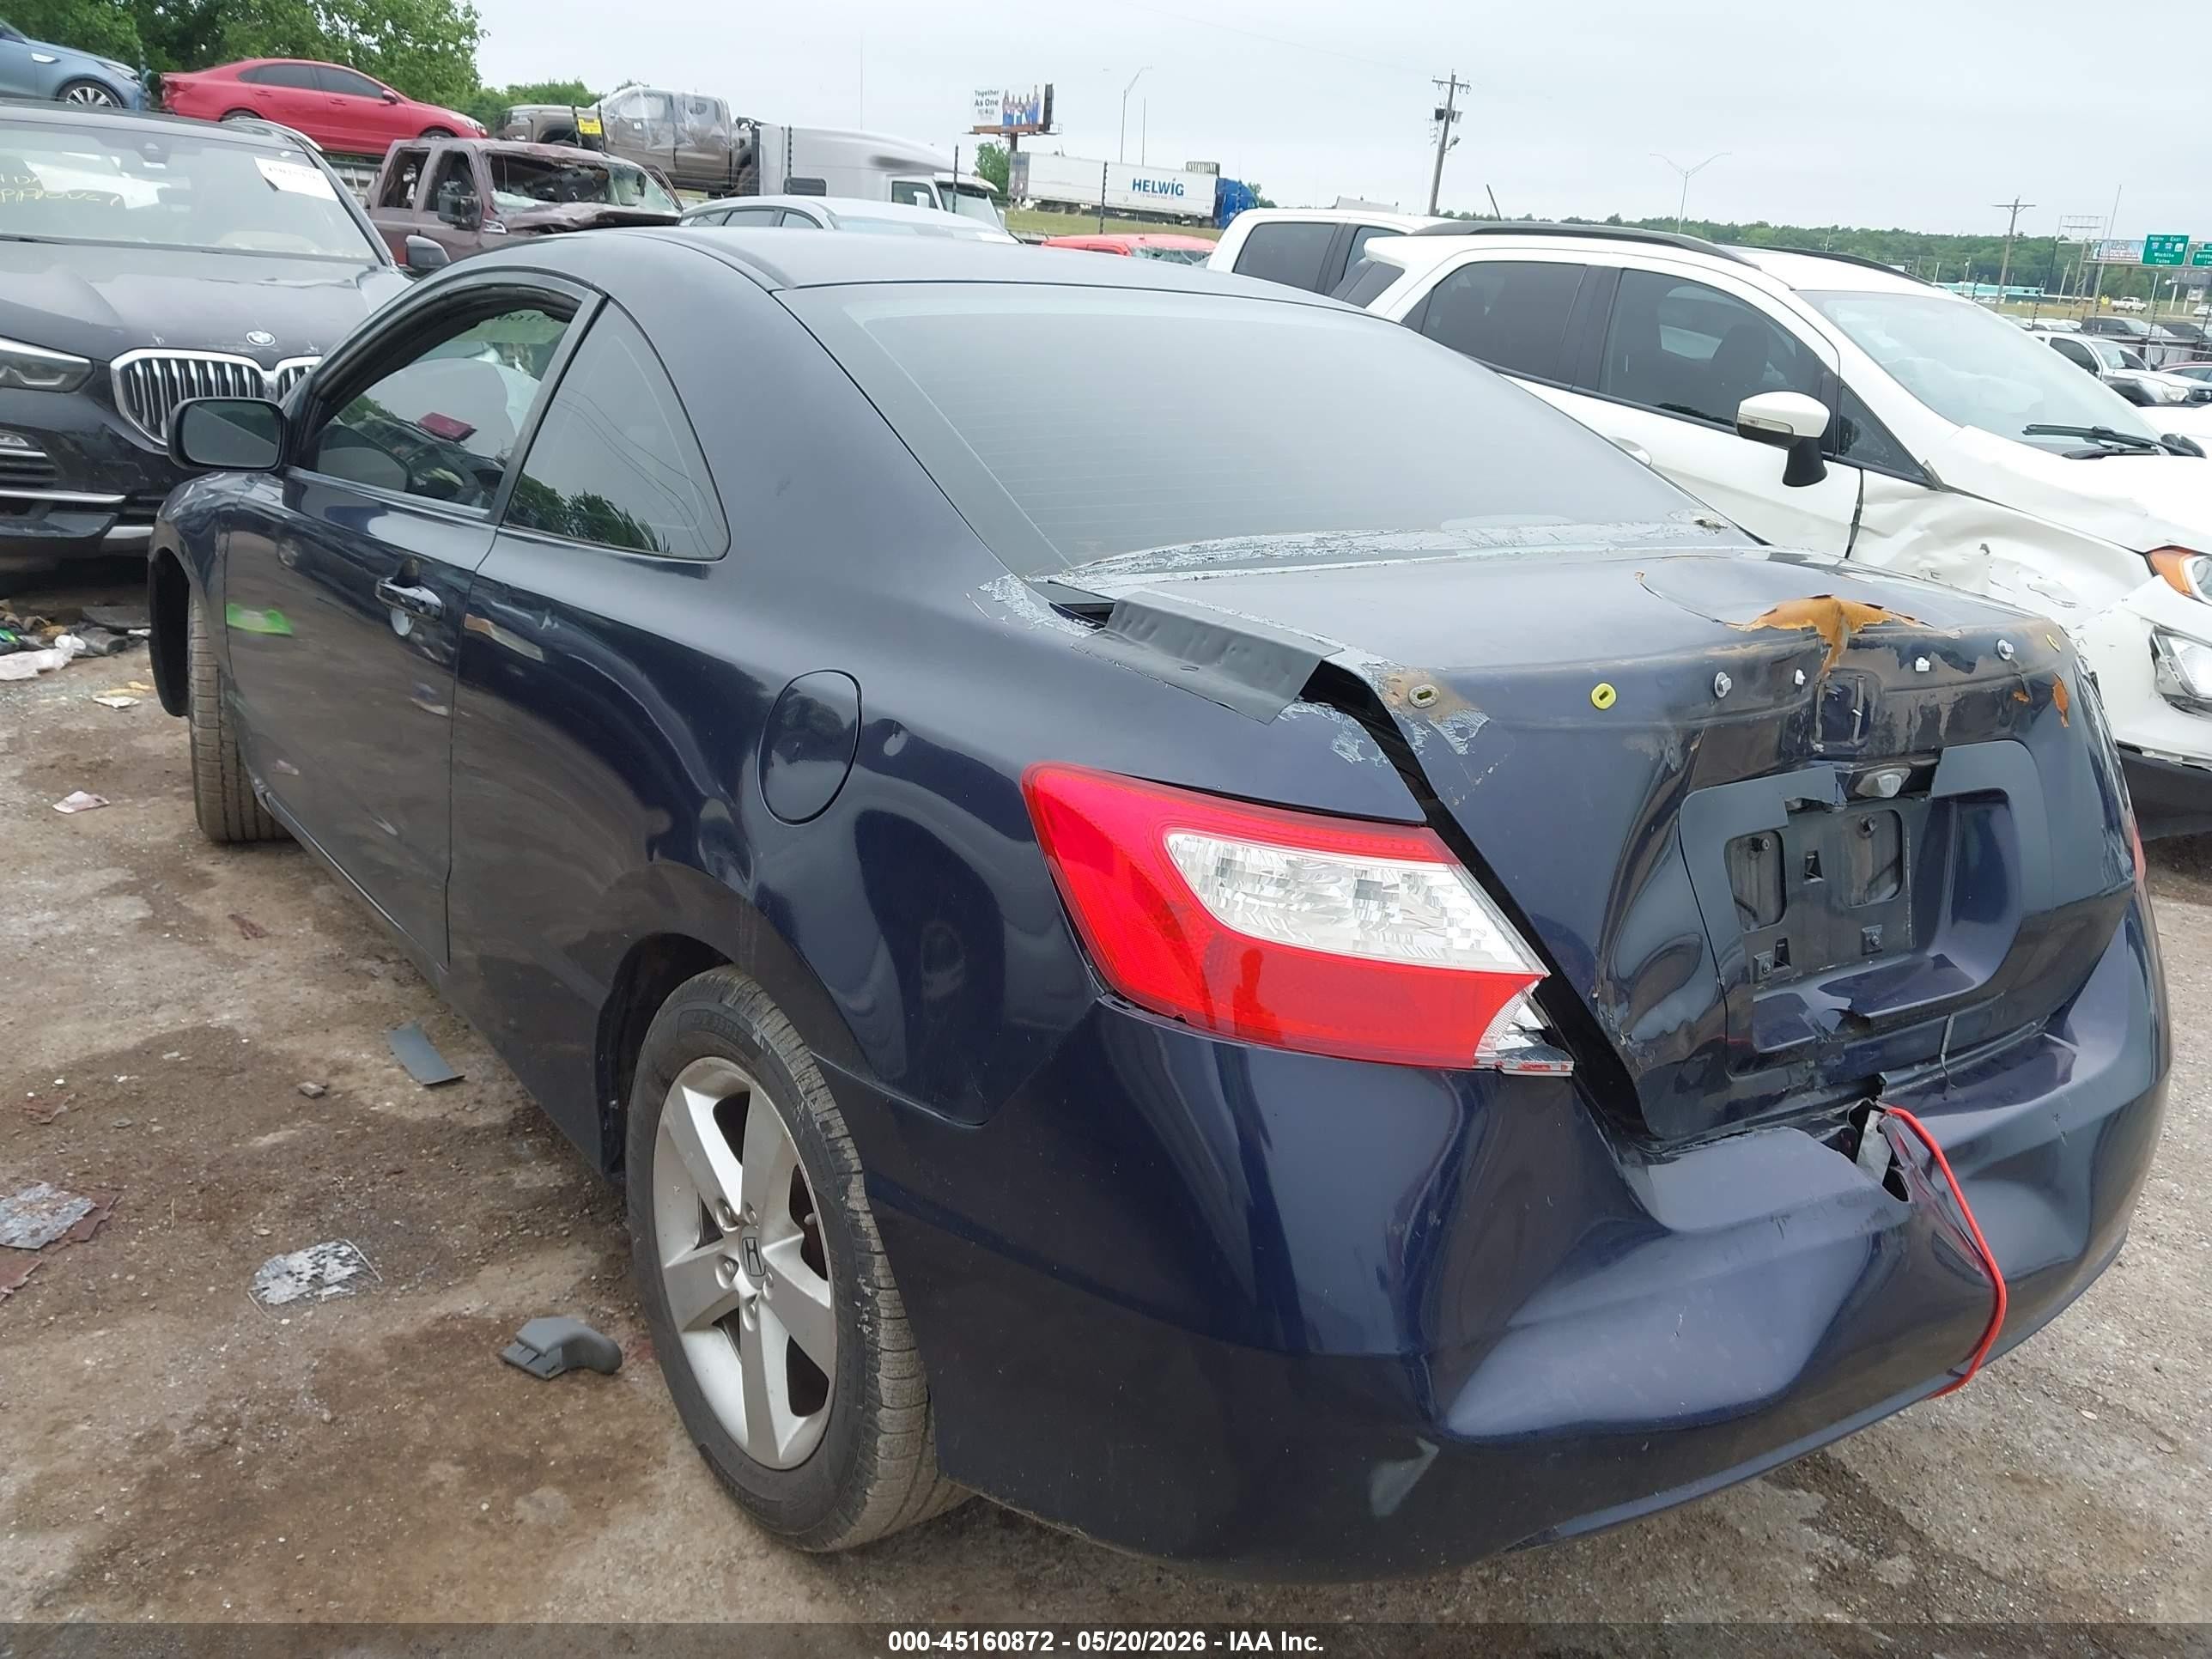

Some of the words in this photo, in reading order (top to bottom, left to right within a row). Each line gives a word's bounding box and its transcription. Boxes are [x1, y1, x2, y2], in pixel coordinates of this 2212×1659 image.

[975, 89, 999, 98] Together
[975, 99, 984, 107] As
[985, 98, 999, 106] One
